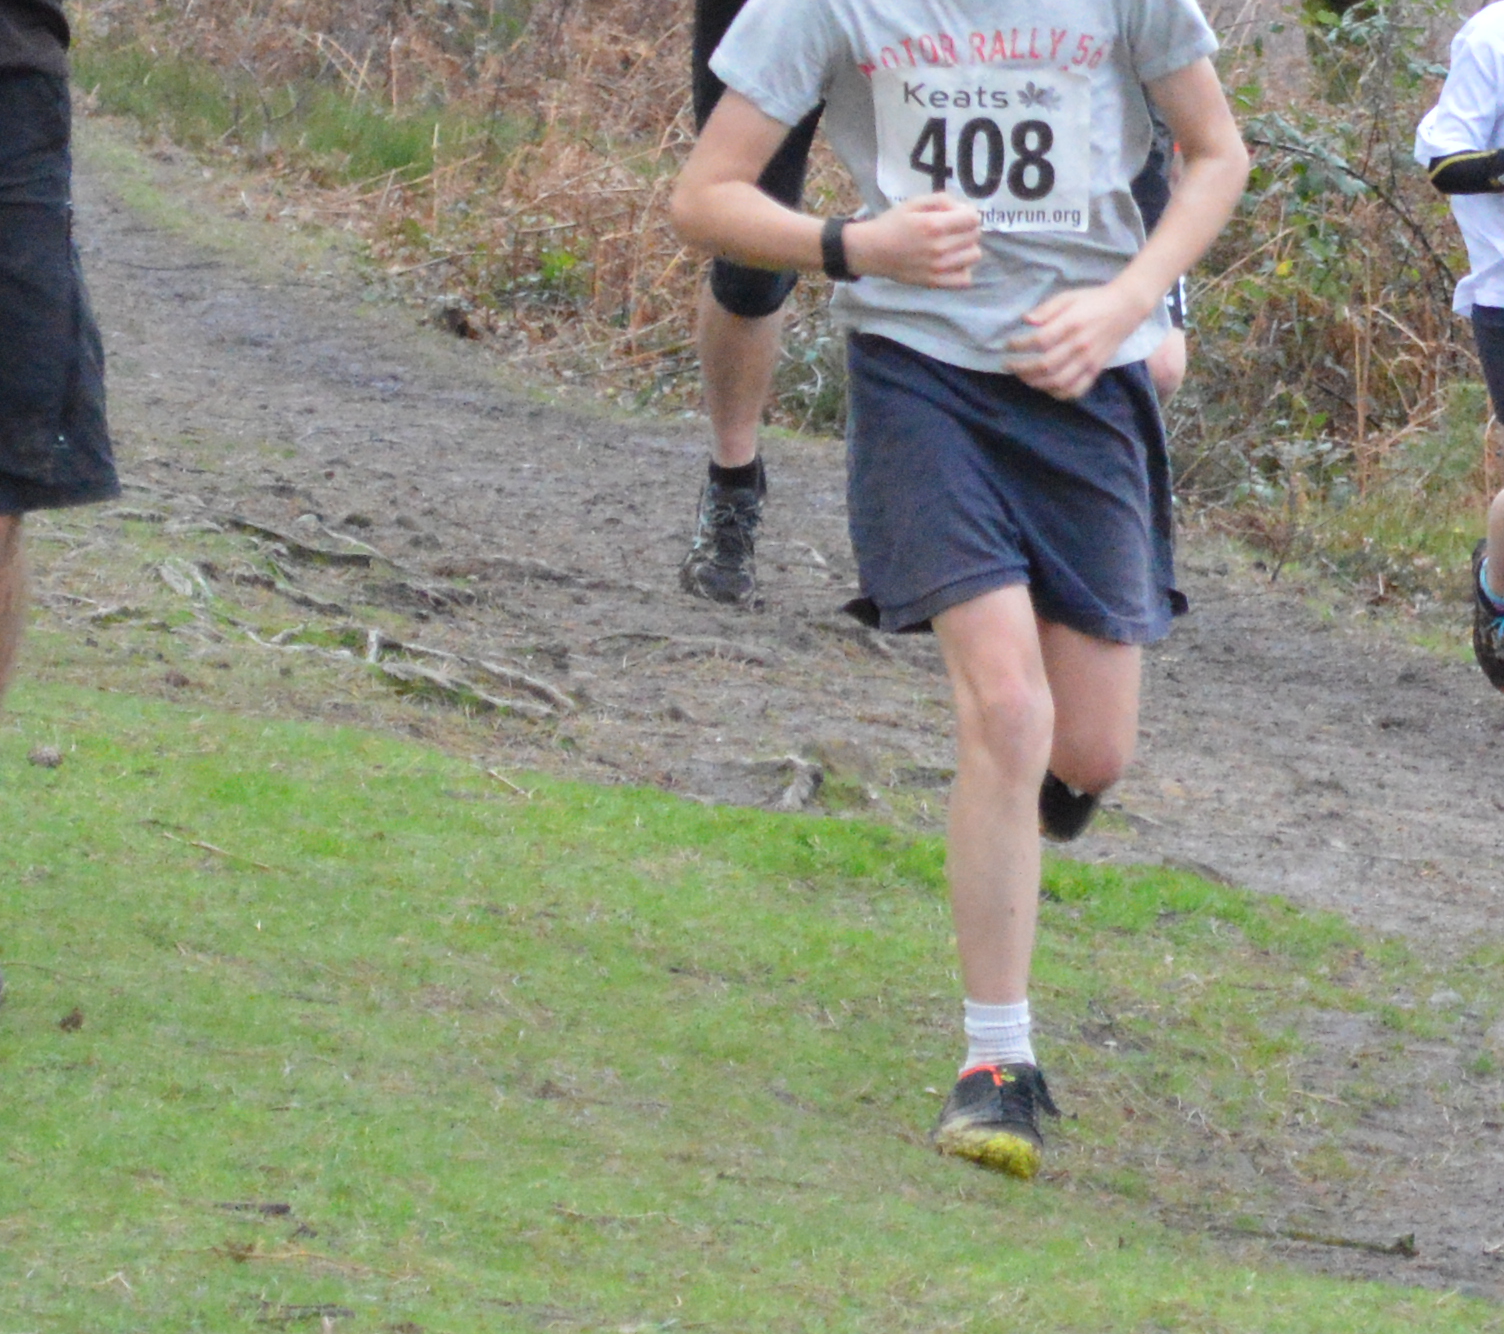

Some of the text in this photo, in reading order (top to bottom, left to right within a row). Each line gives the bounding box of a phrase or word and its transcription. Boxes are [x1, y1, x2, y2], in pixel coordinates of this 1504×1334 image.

[969, 27, 1067, 65] RALLY
[903, 81, 1010, 109] Keats
[909, 117, 1055, 201] 408
